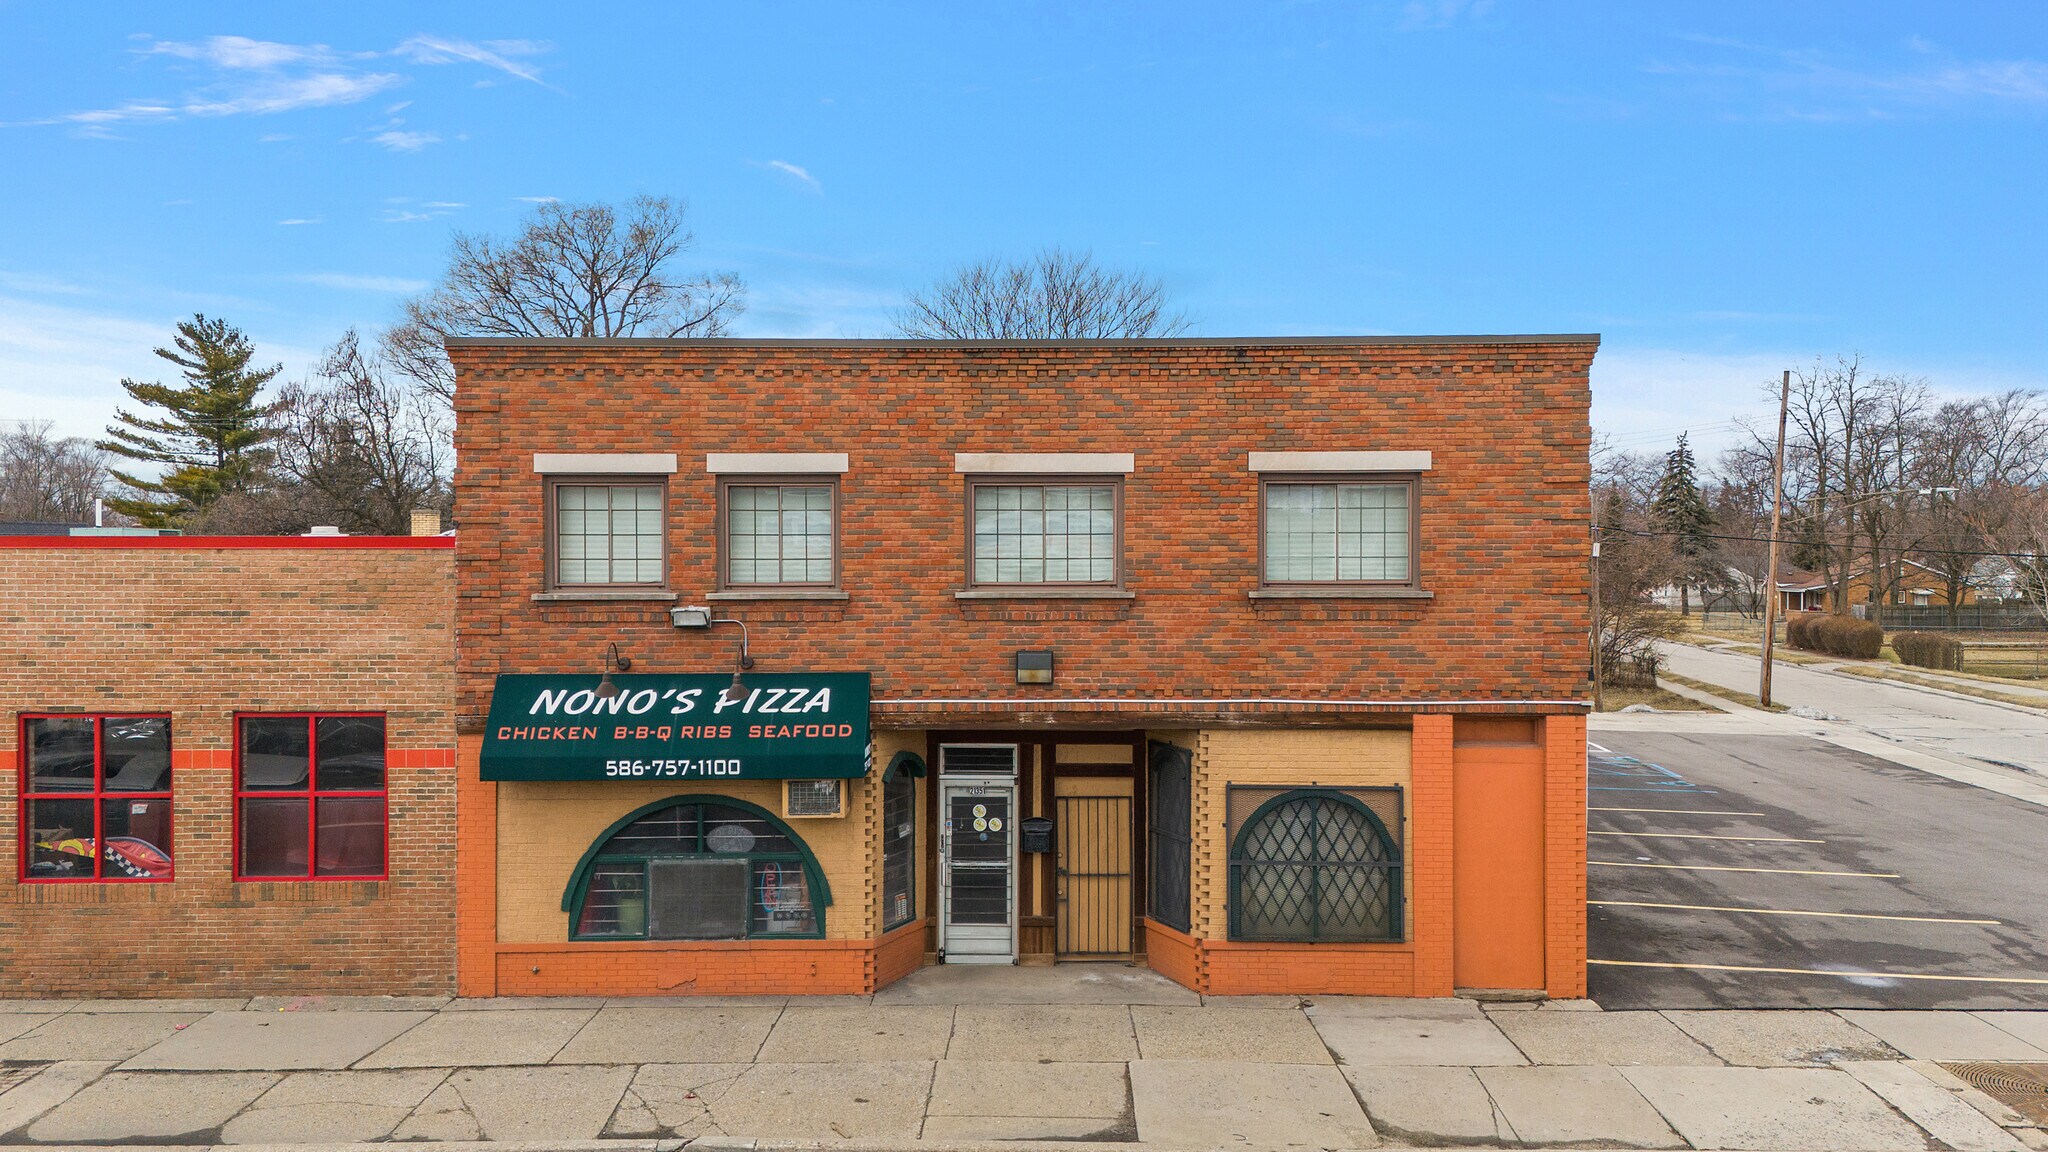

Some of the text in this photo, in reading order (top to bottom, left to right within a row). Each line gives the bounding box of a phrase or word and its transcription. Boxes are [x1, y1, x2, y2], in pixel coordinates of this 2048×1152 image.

[528, 688, 702, 715] NONO'S
[497, 724, 853, 742] CHICKEN B-B-Q RIBS SEAFOOD
[605, 759, 741, 776] 586-757-1100
